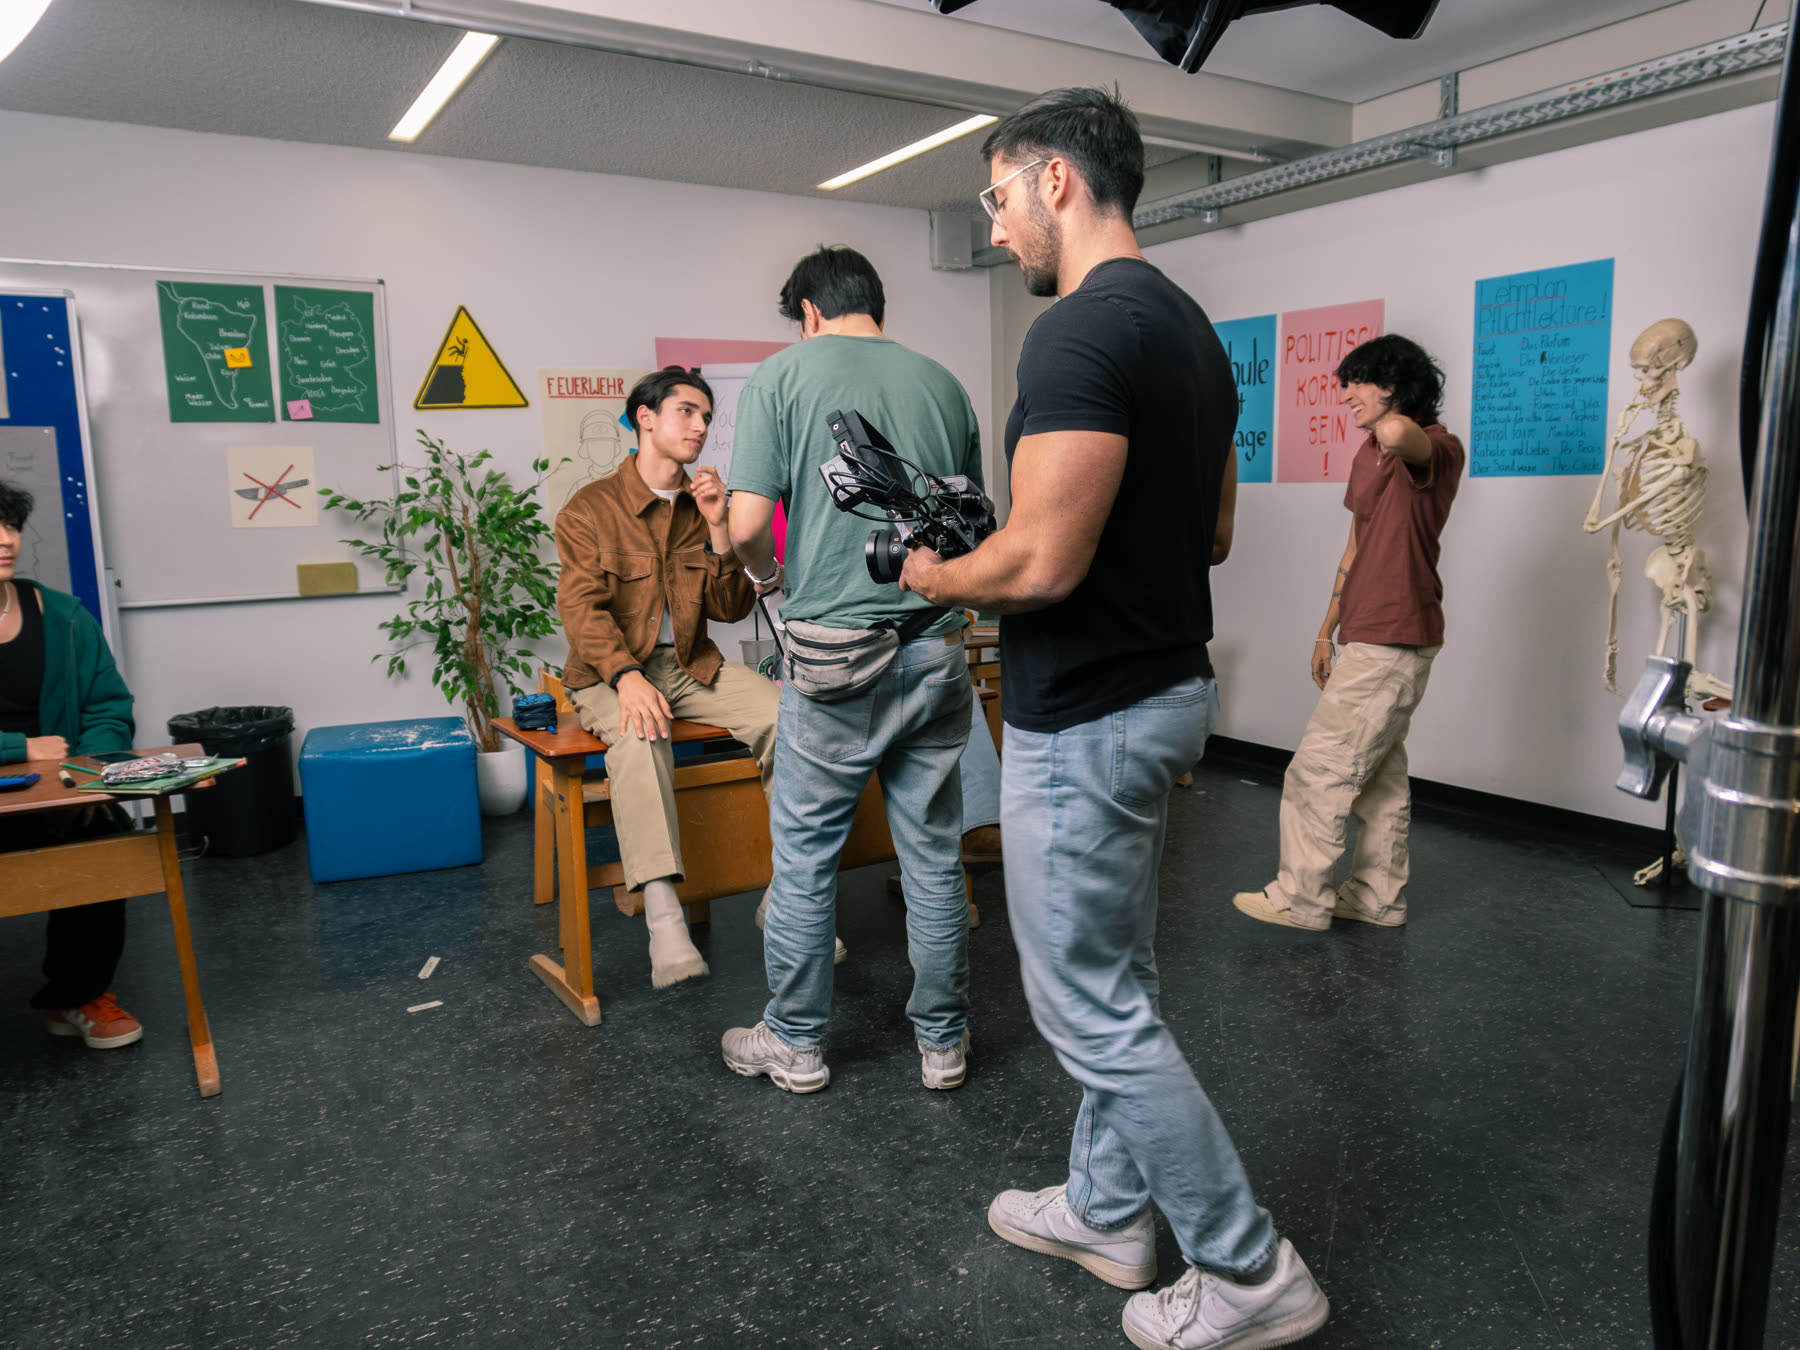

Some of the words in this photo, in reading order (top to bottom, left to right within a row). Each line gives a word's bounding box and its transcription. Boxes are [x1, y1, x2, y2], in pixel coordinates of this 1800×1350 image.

[1228, 337, 1270, 388] hule
[547, 377, 625, 396] FEUERWEHR
[1297, 372, 1345, 408] KORR
[1309, 414, 1347, 445] SEIN
[1234, 430, 1267, 462] age
